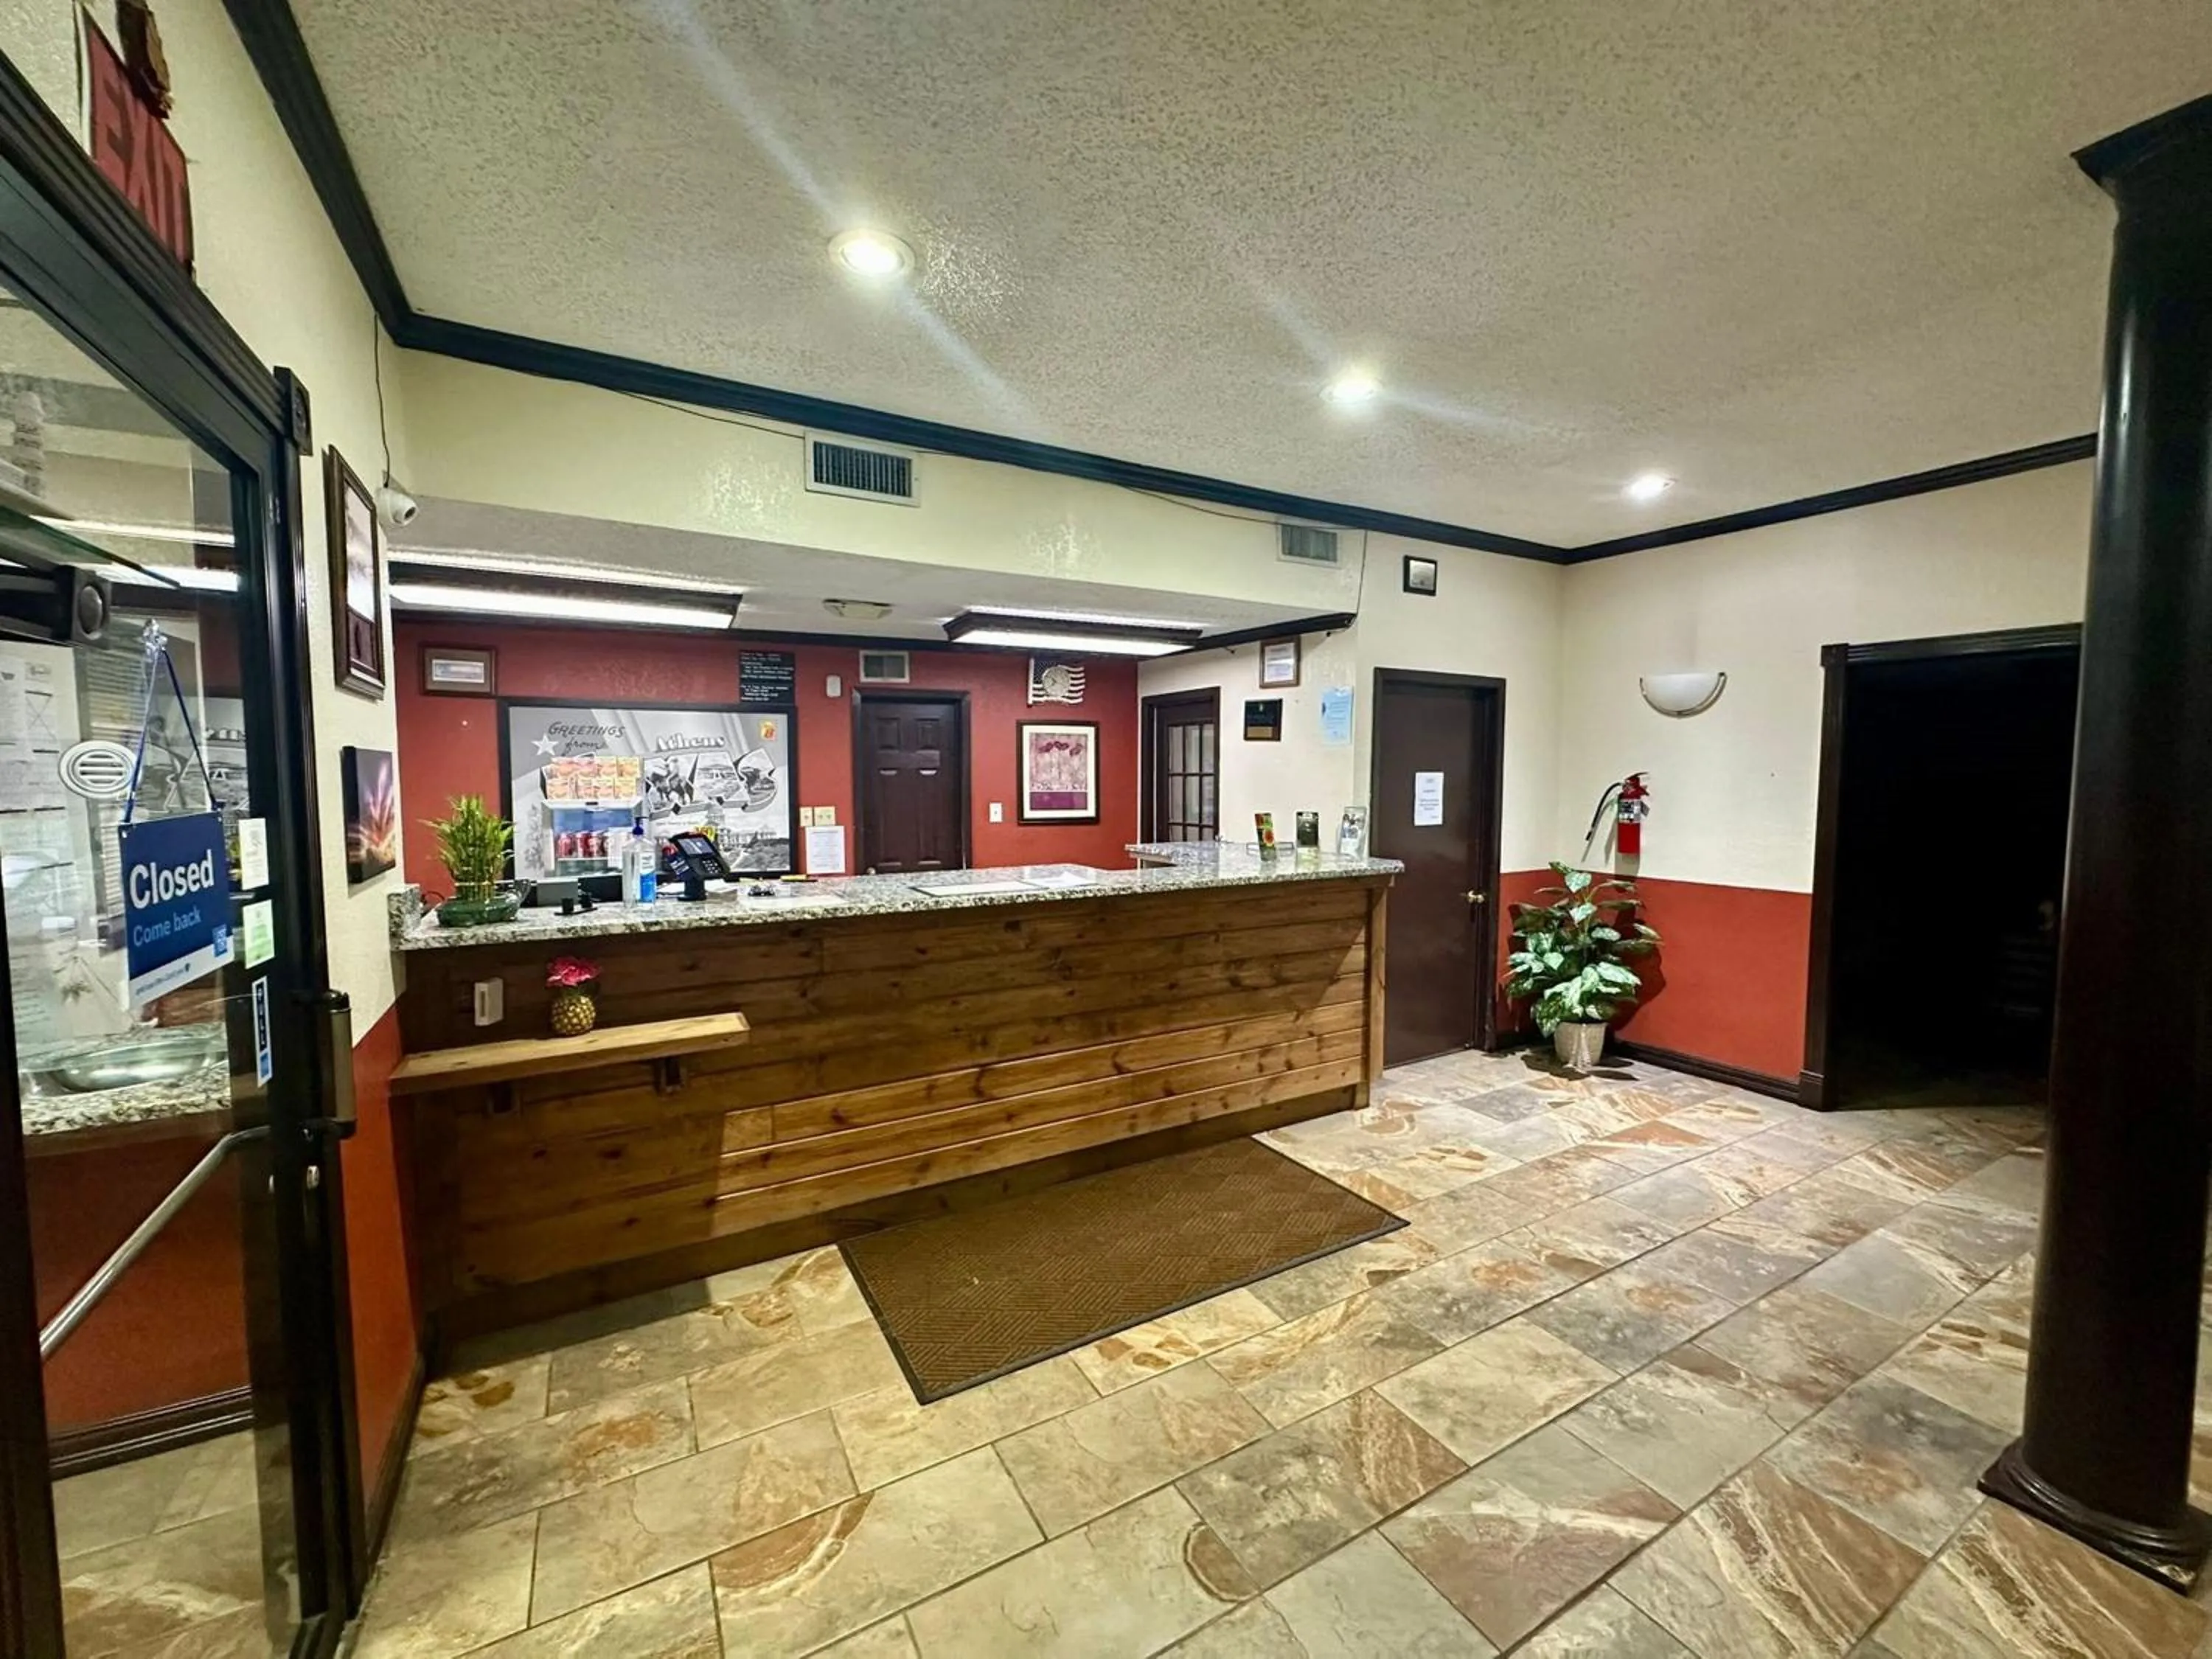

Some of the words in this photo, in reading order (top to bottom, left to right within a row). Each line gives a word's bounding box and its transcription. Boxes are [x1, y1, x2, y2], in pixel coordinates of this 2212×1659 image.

[89, 25, 184, 262] EXIT
[548, 720, 626, 738] GREETINGS
[655, 731, 726, 752] Athens
[129, 849, 215, 909] Closed
[133, 921, 171, 947] Come
[173, 905, 201, 932] back
